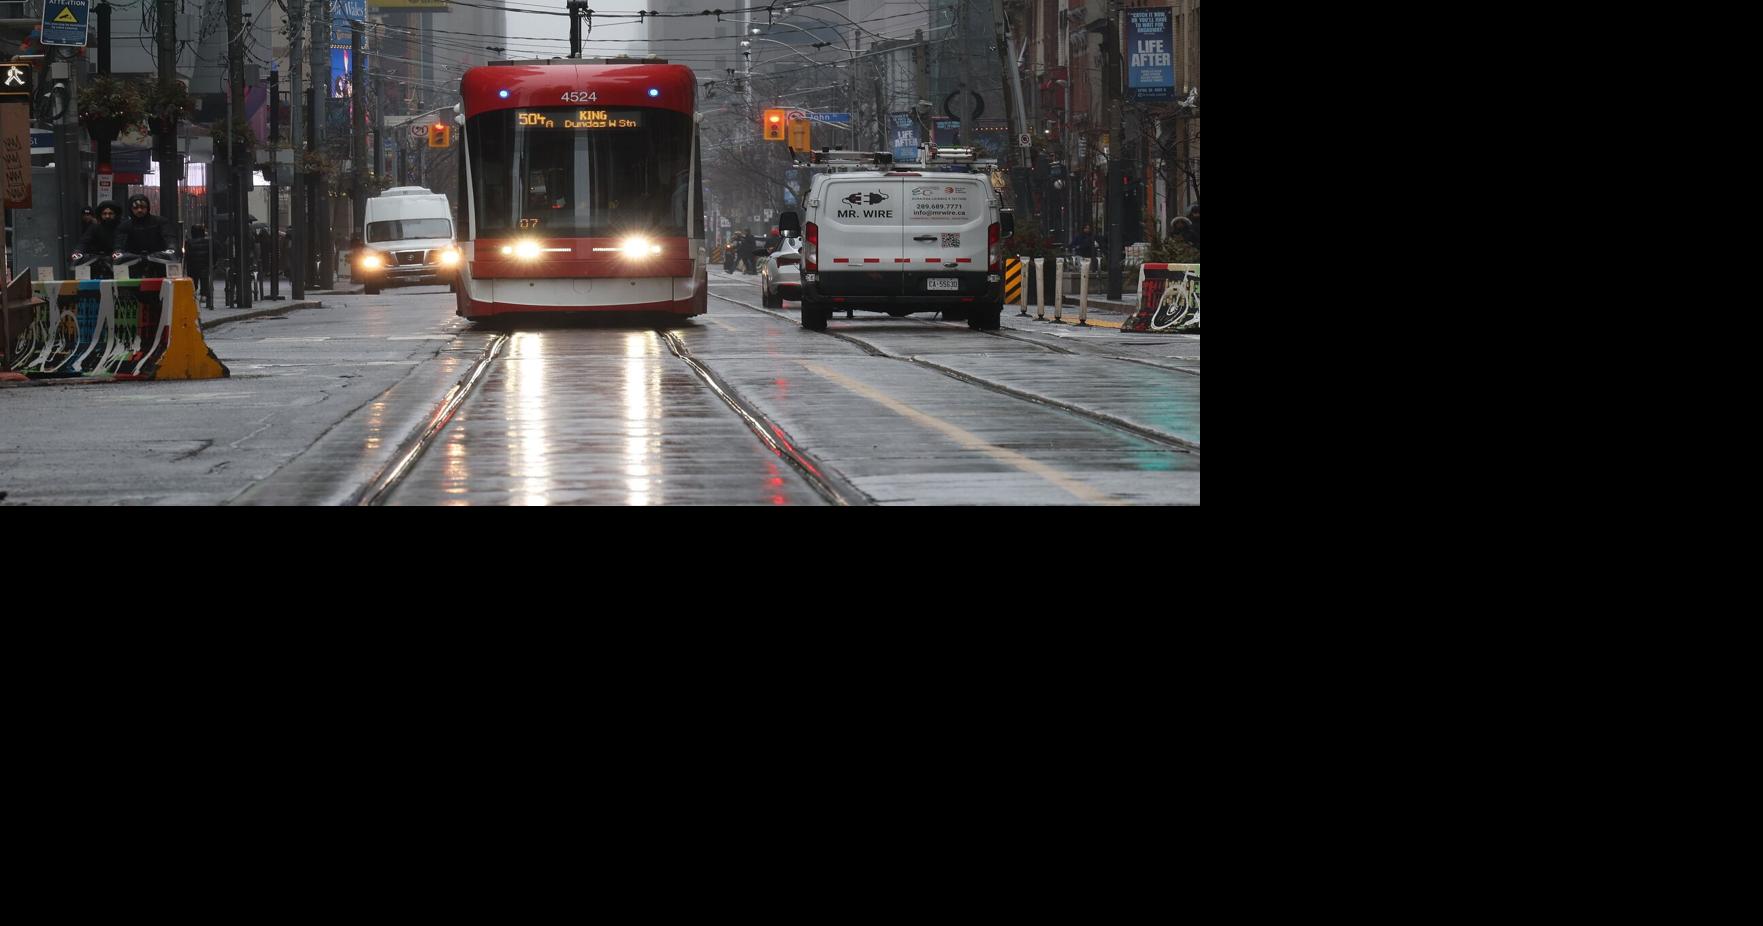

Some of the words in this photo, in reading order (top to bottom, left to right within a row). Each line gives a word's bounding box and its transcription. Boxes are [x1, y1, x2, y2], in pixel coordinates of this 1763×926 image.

[344, 1, 364, 16] Wales
[1137, 40, 1164, 53] LIFE
[1131, 53, 1171, 67] AFTER
[561, 91, 597, 102] 4524
[579, 110, 608, 120] KING
[810, 113, 830, 121] John
[564, 119, 606, 128] Dundas
[608, 120, 616, 128] W
[618, 119, 636, 128] Stn
[897, 130, 913, 139] LIFE
[894, 137, 918, 148] AFTER
[837, 209, 859, 219] MR.
[863, 209, 894, 219] WIRE
[519, 218, 539, 228] 07
